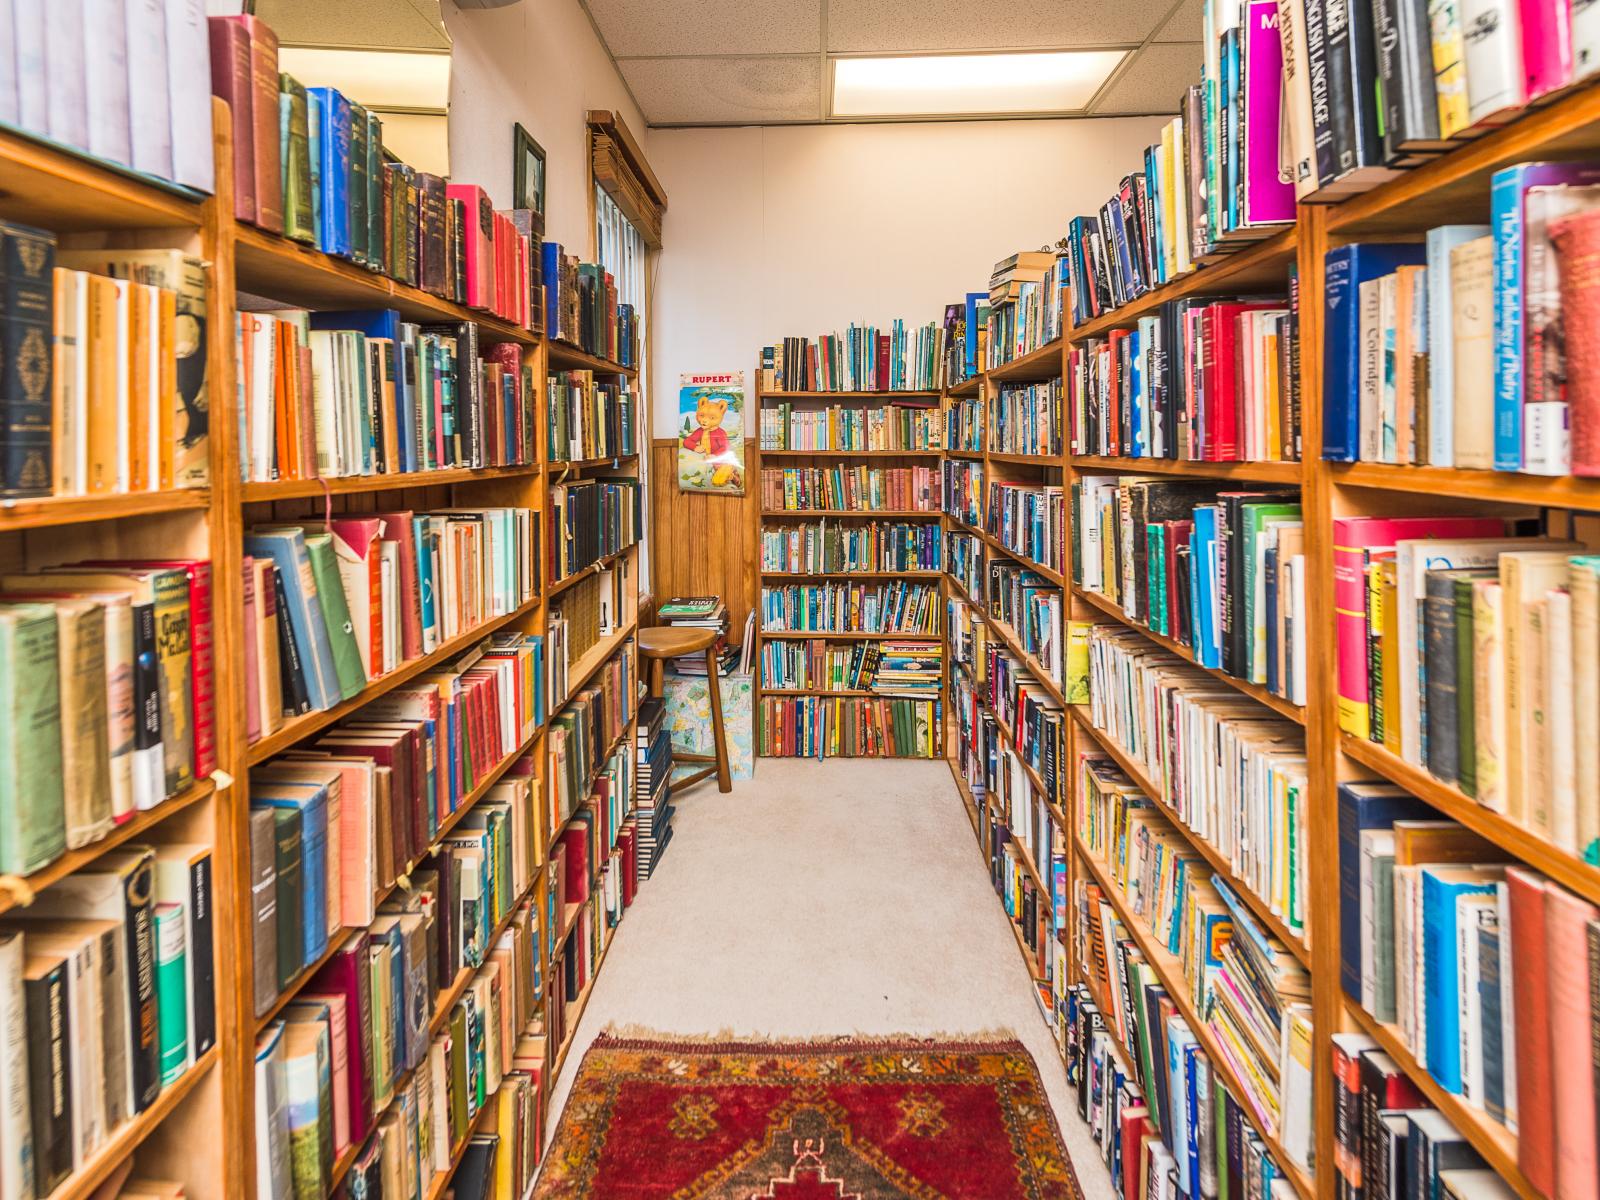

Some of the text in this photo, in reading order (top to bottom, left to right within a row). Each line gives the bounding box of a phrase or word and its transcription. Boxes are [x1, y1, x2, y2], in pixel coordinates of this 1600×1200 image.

[1309, 54, 1329, 128] LANGUAGE
[1315, 130, 1333, 149] II
[1501, 207, 1521, 233] The
[1501, 234, 1520, 280] Norton
[1497, 281, 1520, 346] Anthology
[1292, 340, 1300, 374] JESUS
[1366, 328, 1378, 395] Coleridge
[692, 375, 732, 384] RUPERT
[1498, 360, 1520, 400] Poetry
